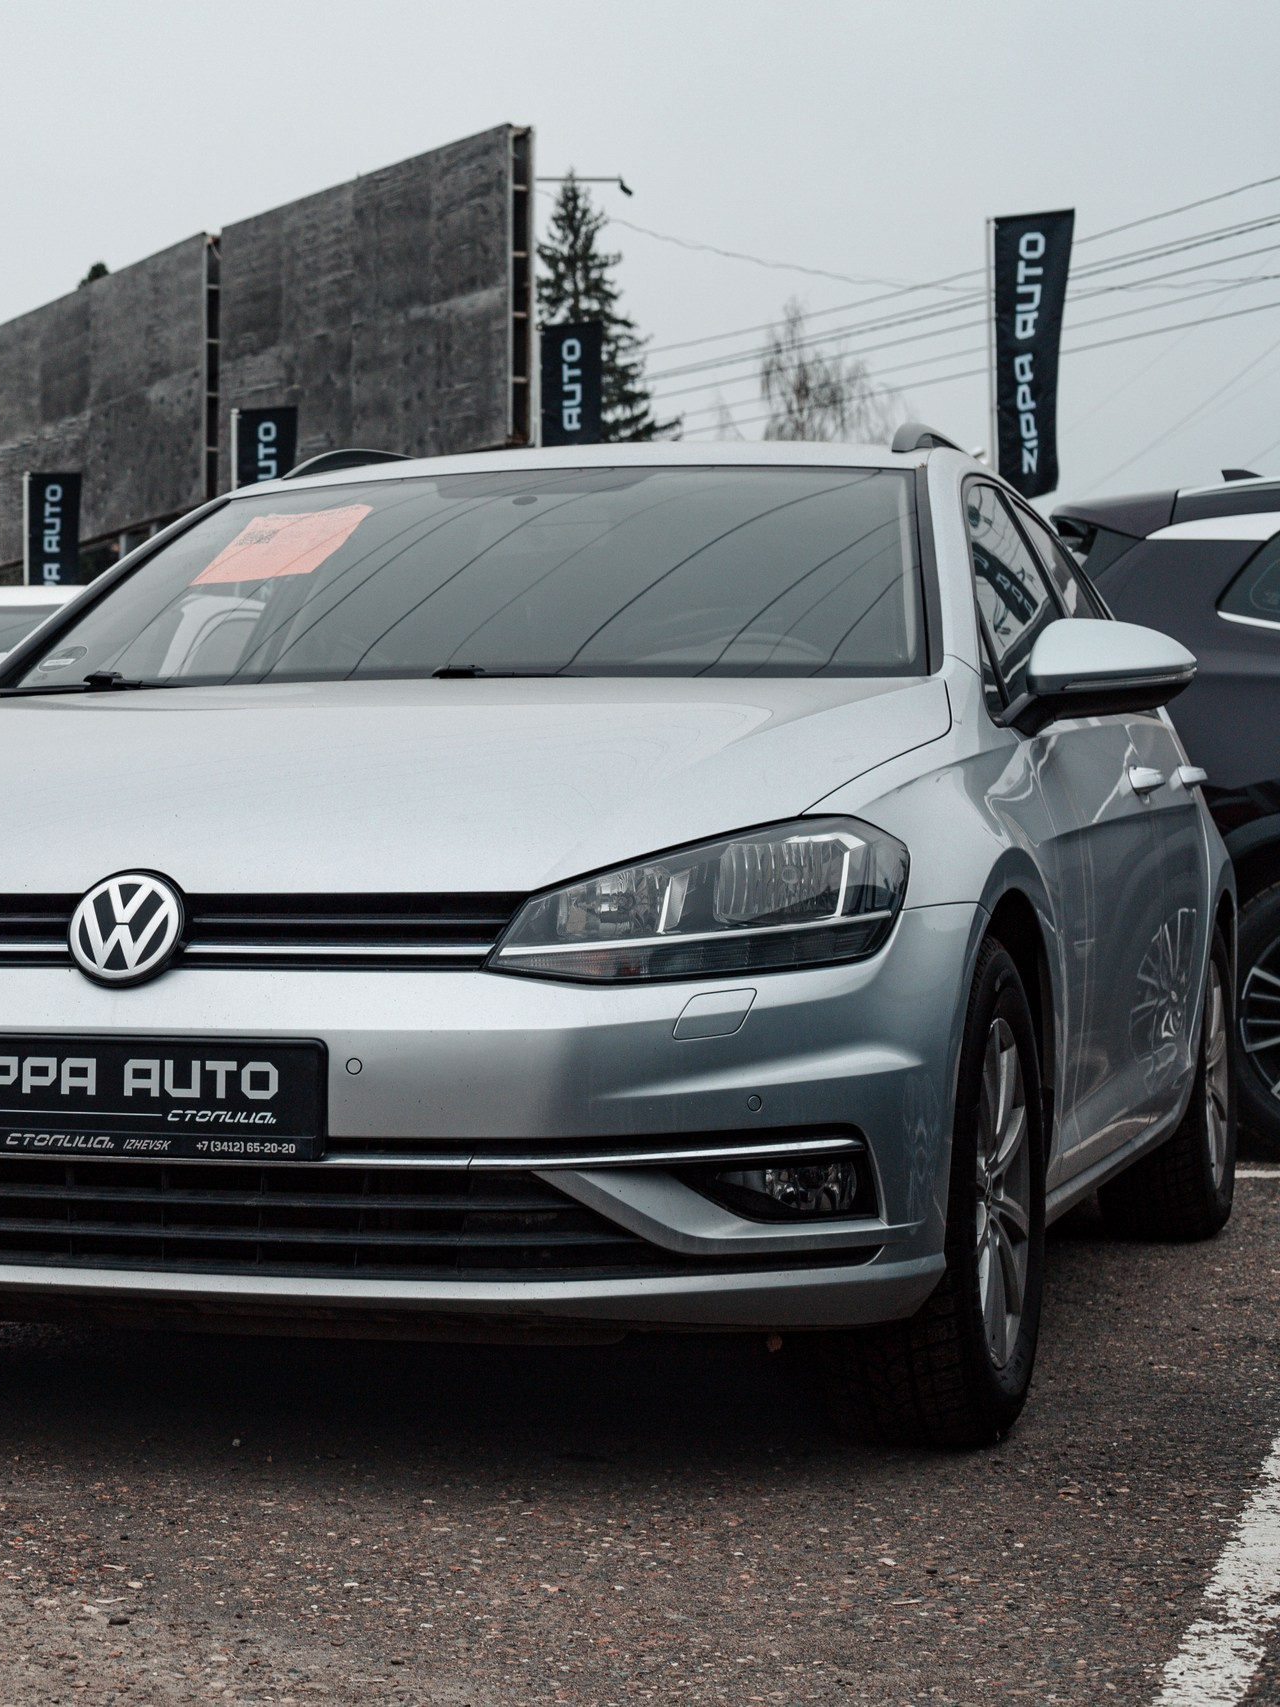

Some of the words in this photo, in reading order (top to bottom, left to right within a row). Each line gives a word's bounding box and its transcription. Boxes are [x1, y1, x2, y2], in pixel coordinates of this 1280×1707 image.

[1014, 231, 1046, 340] AUTO
[561, 338, 582, 431] AUTO
[1014, 353, 1039, 475] ZIPPA
[257, 421, 277, 480] UTO
[43, 484, 63, 554] AUTO
[123, 1058, 280, 1100] AUTO
[122, 1138, 172, 1151] IZHEVSK
[195, 1140, 209, 1152] +7
[210, 1140, 245, 1153] (3412)
[246, 1141, 297, 1154] 65-20-20
